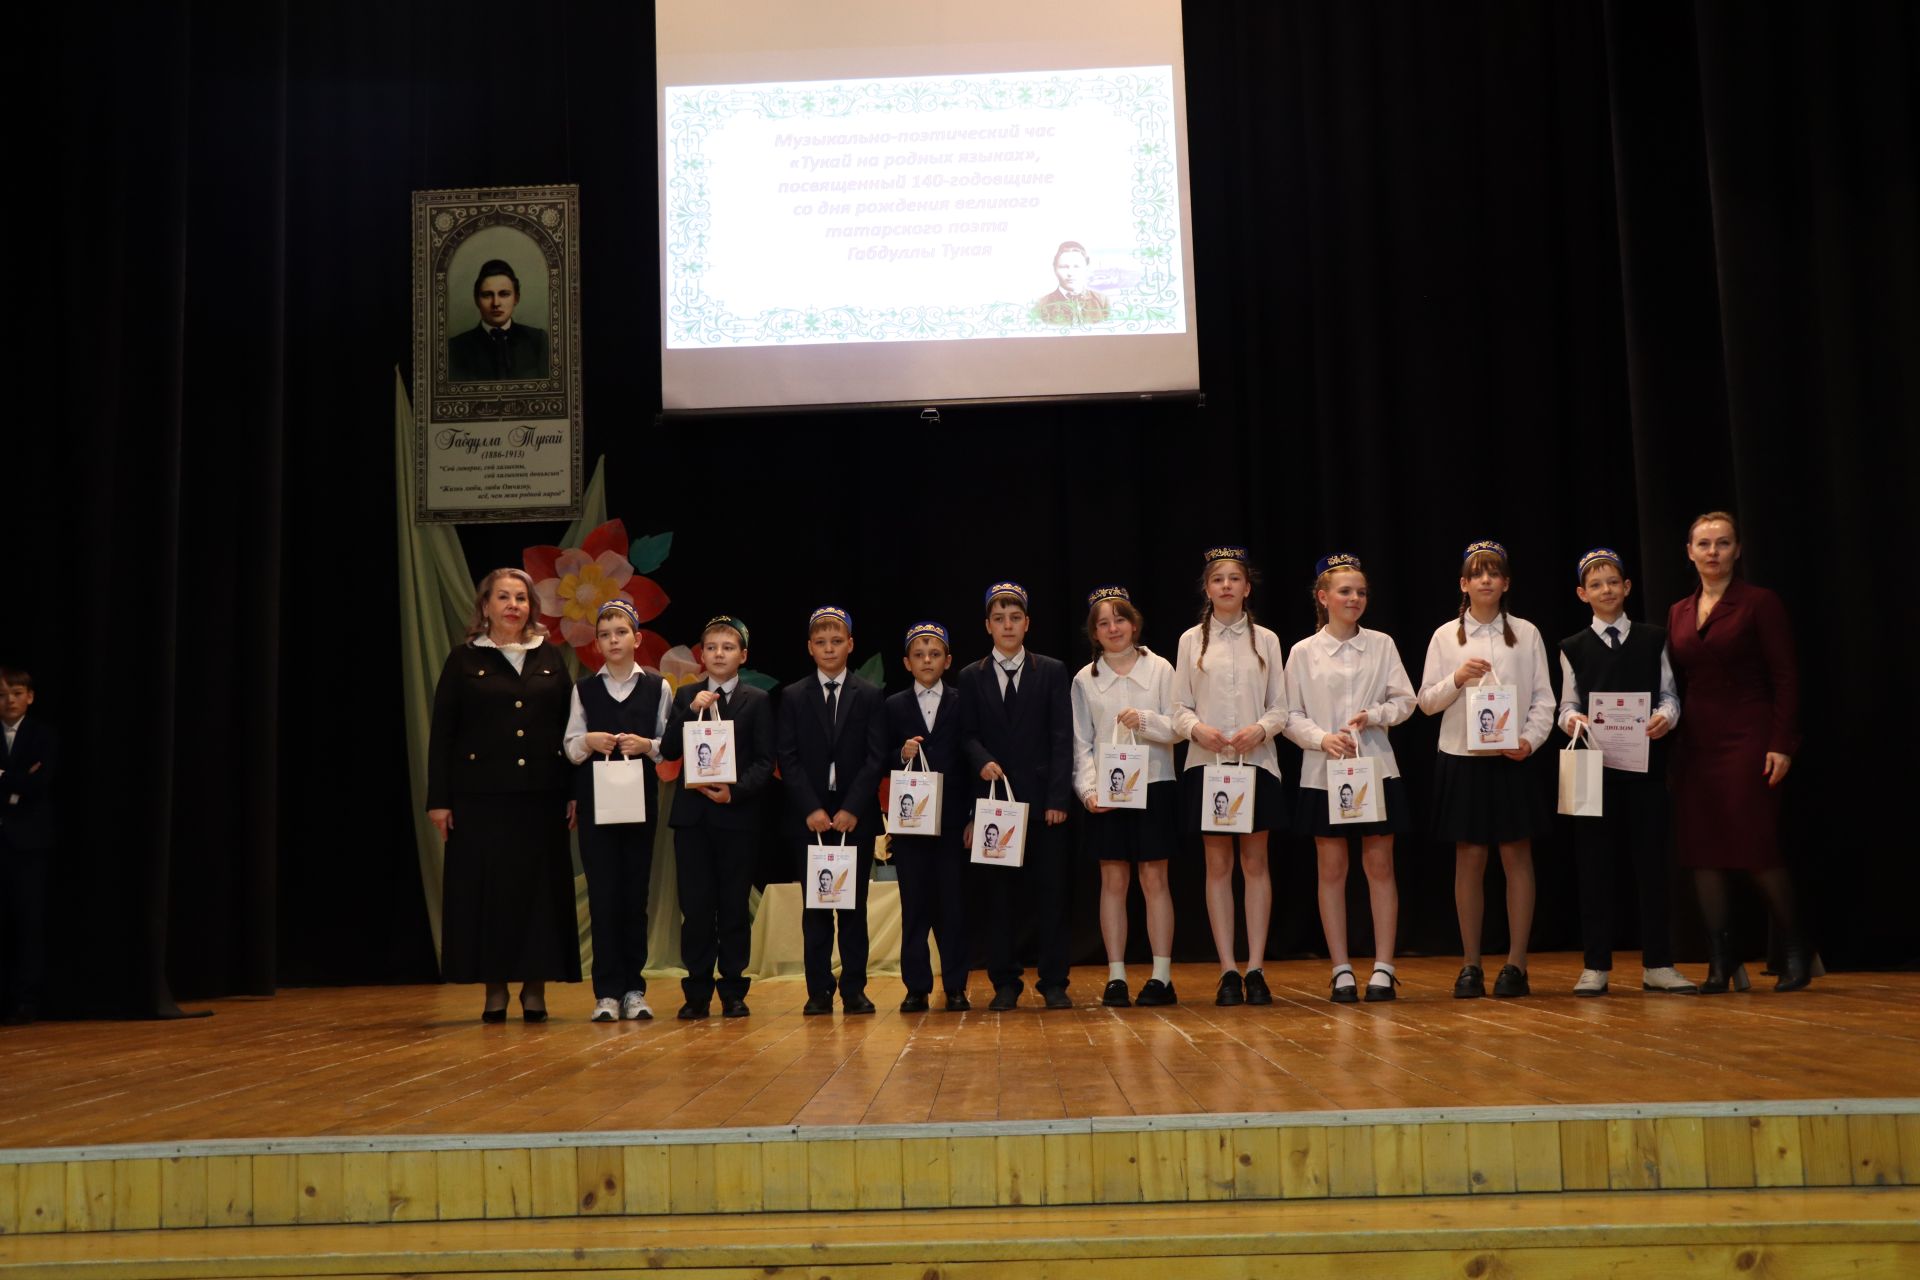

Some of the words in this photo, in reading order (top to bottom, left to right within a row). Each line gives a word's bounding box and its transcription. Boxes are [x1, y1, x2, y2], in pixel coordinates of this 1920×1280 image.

[774, 124, 1020, 150] Музыкально-поэтический
[1024, 126, 1056, 140] час
[789, 153, 852, 172] «Тукай
[857, 156, 879, 168] на
[884, 151, 953, 169] родных
[958, 149, 1041, 164] языках»,
[778, 174, 906, 194] посвященный
[911, 171, 1055, 189] 140-годовщине
[793, 203, 813, 216] со
[817, 200, 850, 215] дня
[855, 197, 949, 217] рождения
[954, 195, 1041, 210] великого
[825, 221, 942, 239] татарского
[948, 219, 1009, 234] поэта
[847, 245, 935, 263] Габдуллы
[941, 243, 993, 260] Тукая
[435, 428, 501, 454] Габдулла
[508, 425, 564, 451] Тукай
[481, 450, 525, 460] (1886-1913)
